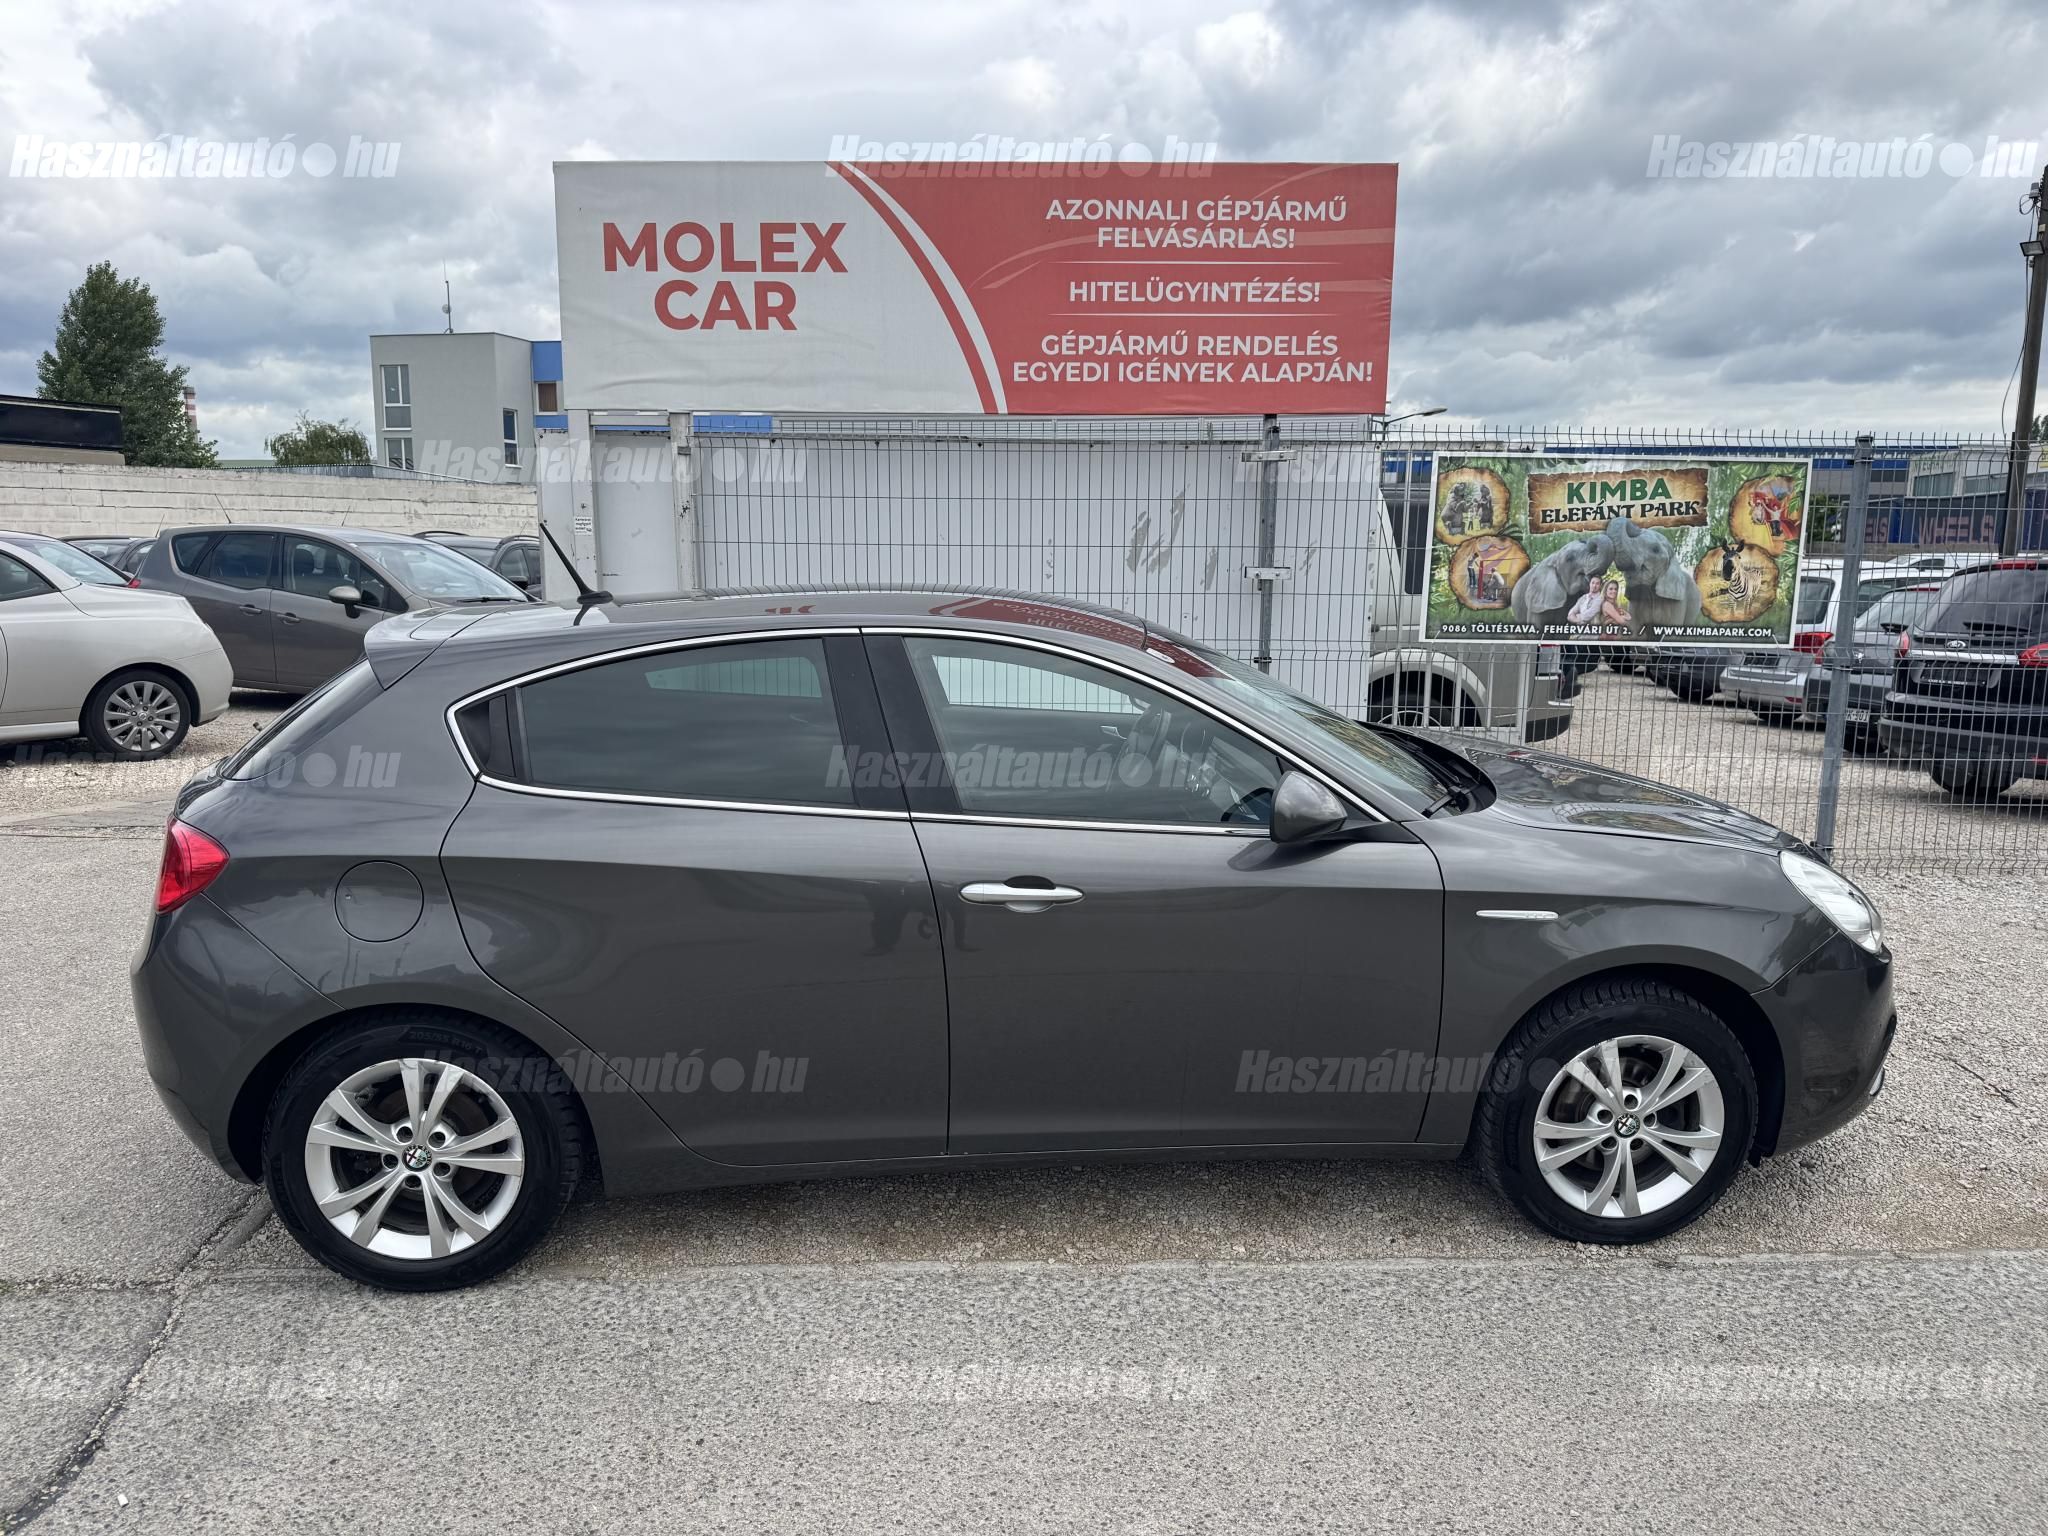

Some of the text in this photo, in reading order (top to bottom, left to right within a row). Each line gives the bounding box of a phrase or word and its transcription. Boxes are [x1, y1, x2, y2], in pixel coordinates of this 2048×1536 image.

[1046, 195, 1348, 224] AZONNALI GÉPJÁRMŰ
[602, 222, 848, 273] MOLEX
[1098, 222, 1296, 250] FELVÁSÁRLÁS!
[1069, 276, 1322, 304] HITELÜGYINTÉZÉS!
[654, 280, 798, 331] CAR
[1041, 329, 1339, 360] GÉPJÁRMŰ RENDELÉS
[1013, 357, 1374, 384] EGYEDI IGÉNYEK ALAPJÁN!
[1567, 477, 1672, 505] KIMBA
[1541, 499, 1699, 524] ELEFÁNT PARK
[1442, 624, 1467, 633] 9086
[1471, 622, 1540, 634] TÖLTÉSTAVA,
[1544, 623, 1602, 634] FEHÉRVÁRI
[1606, 624, 1620, 634] ÚT
[1622, 626, 1631, 635] 2.
[1653, 626, 1772, 637] WWW.KIMBAPARK.COM
